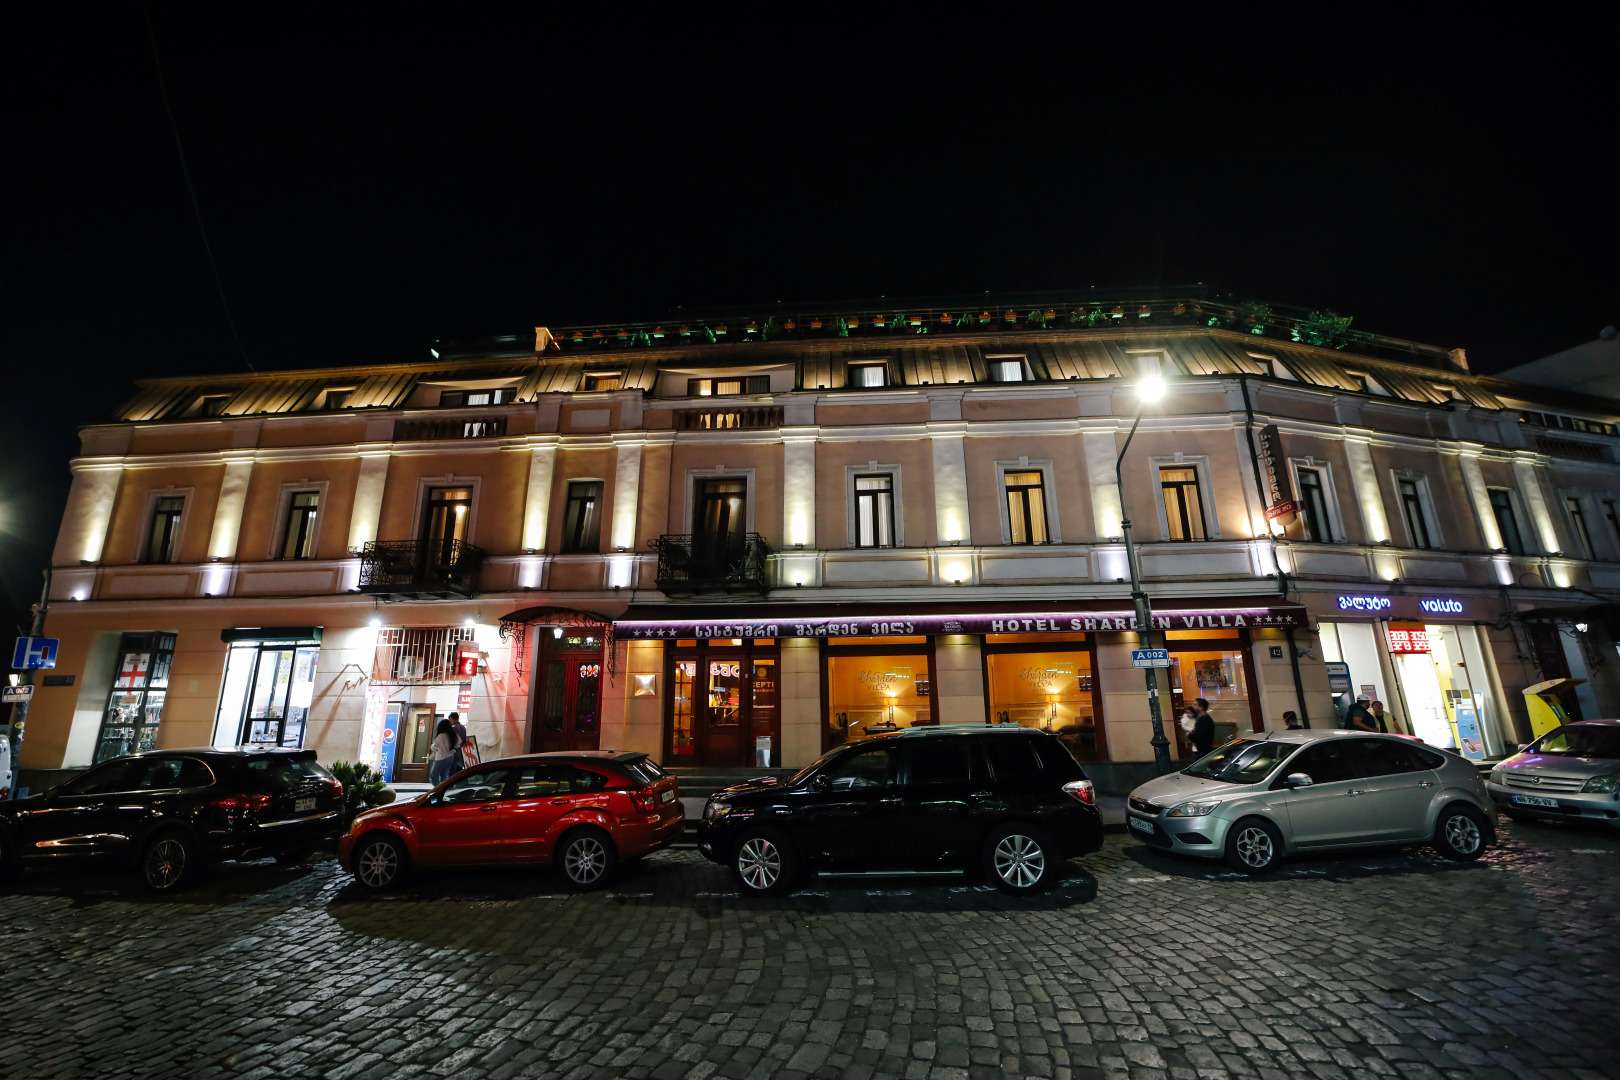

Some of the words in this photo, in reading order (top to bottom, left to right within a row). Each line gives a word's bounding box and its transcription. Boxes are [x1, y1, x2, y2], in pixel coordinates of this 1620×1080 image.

[1338, 596, 1391, 610] ვალუტო
[1420, 599, 1463, 612] valuto
[695, 624, 779, 637] სასტუმრო
[795, 623, 858, 636] შარდენ
[871, 622, 914, 634] ვილა
[991, 619, 1061, 632] HOTEL
[1070, 616, 1171, 631] SHARDN
[1183, 615, 1247, 628] VILLA
